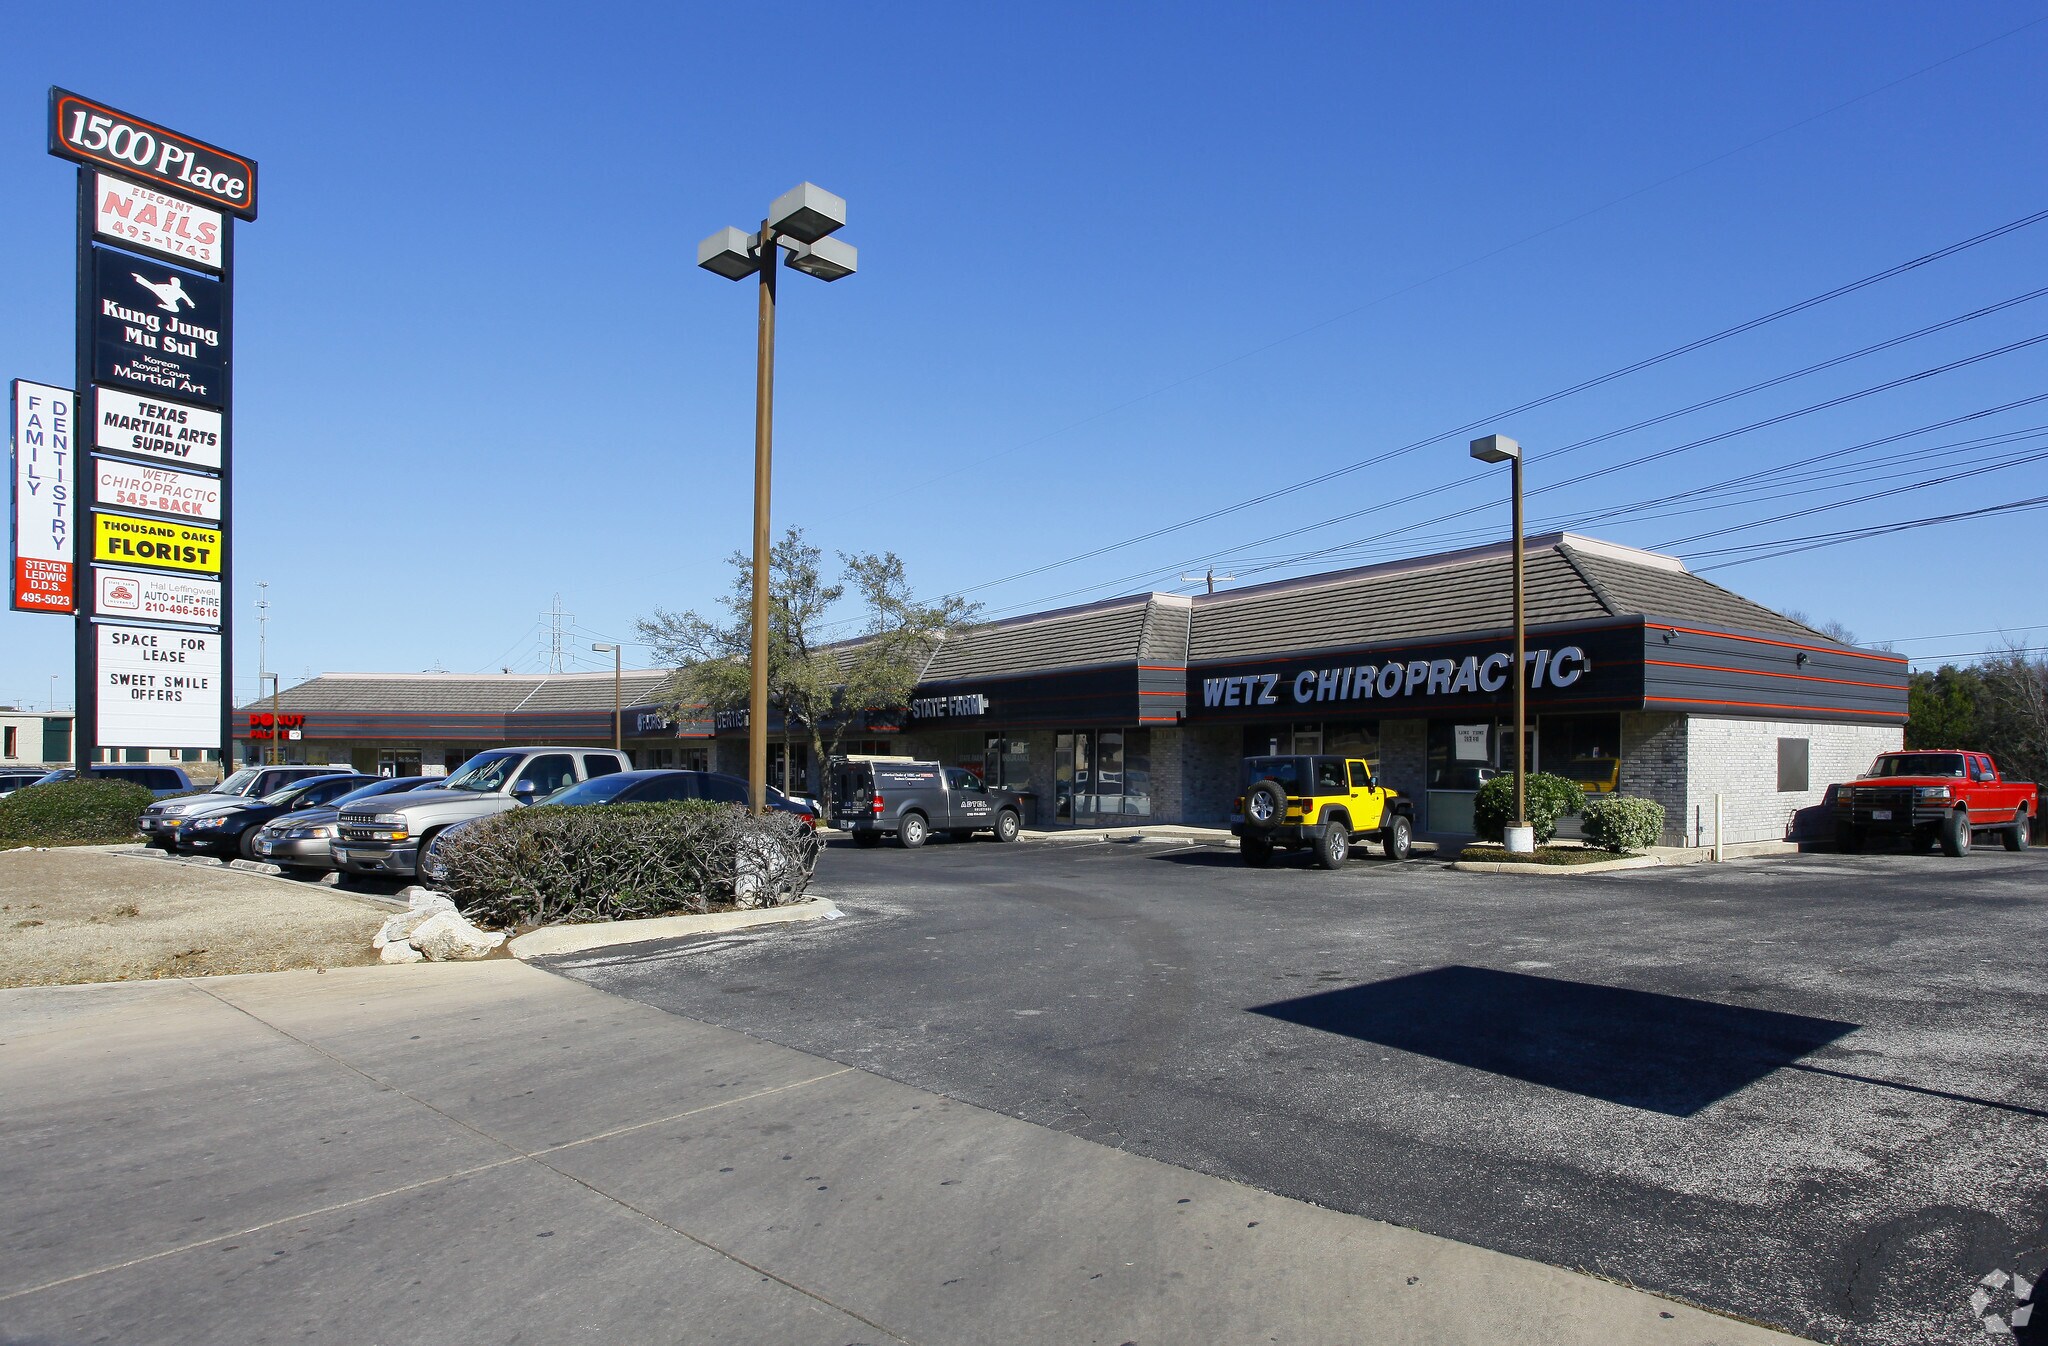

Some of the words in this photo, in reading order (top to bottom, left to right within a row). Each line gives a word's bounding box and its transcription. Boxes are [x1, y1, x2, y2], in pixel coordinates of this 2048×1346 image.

[69, 111, 156, 167] 1500
[155, 141, 245, 199] Place
[132, 187, 193, 213] ELEGANT
[102, 191, 218, 245] NAILS
[112, 220, 211, 261] 495-1743
[102, 299, 161, 332] Kung
[166, 316, 219, 347] Jung
[125, 326, 157, 349] Mu
[162, 336, 197, 358] Sul
[132, 360, 160, 373] Royal
[162, 368, 191, 380] Court
[143, 355, 180, 370] Korean
[114, 364, 176, 389] Martial
[179, 380, 208, 396] Art
[138, 402, 189, 424] TEXAS
[104, 412, 174, 438] MARTIAL
[177, 428, 218, 447] ARTS
[25, 395, 44, 497] FAMILY
[132, 434, 192, 458] SUPPLY
[52, 400, 68, 551] DENTISTRY
[142, 468, 179, 484] WETZ
[100, 474, 218, 503] CHIROPRACTIC
[116, 490, 203, 515] 545-BACK
[103, 520, 176, 538] THOUSAND
[181, 531, 216, 544] OAKS
[108, 537, 211, 565] FLORIST
[25, 560, 67, 573] STEVEN
[25, 570, 67, 583] LEDWIG
[31, 580, 62, 592] D.D.S.
[150, 581, 166, 591] Hal
[168, 583, 216, 596] Leffingwell
[21, 593, 70, 606] 495-5023
[144, 591, 169, 602] AUTO
[176, 594, 194, 605] LIFE
[201, 597, 220, 607] FIRE
[145, 602, 219, 618] 210-496-5616
[112, 632, 158, 647] SPACE
[181, 638, 205, 651] FOR
[143, 650, 185, 663] LEASE
[110, 673, 156, 687] SWEET
[164, 676, 208, 689] SMILE
[1203, 673, 1281, 707] WETZ
[131, 688, 183, 701] OFFERS
[912, 695, 946, 719] STATE
[948, 693, 985, 717] FARM
[249, 713, 304, 727] DONUT
[249, 729, 290, 739] PALAE
